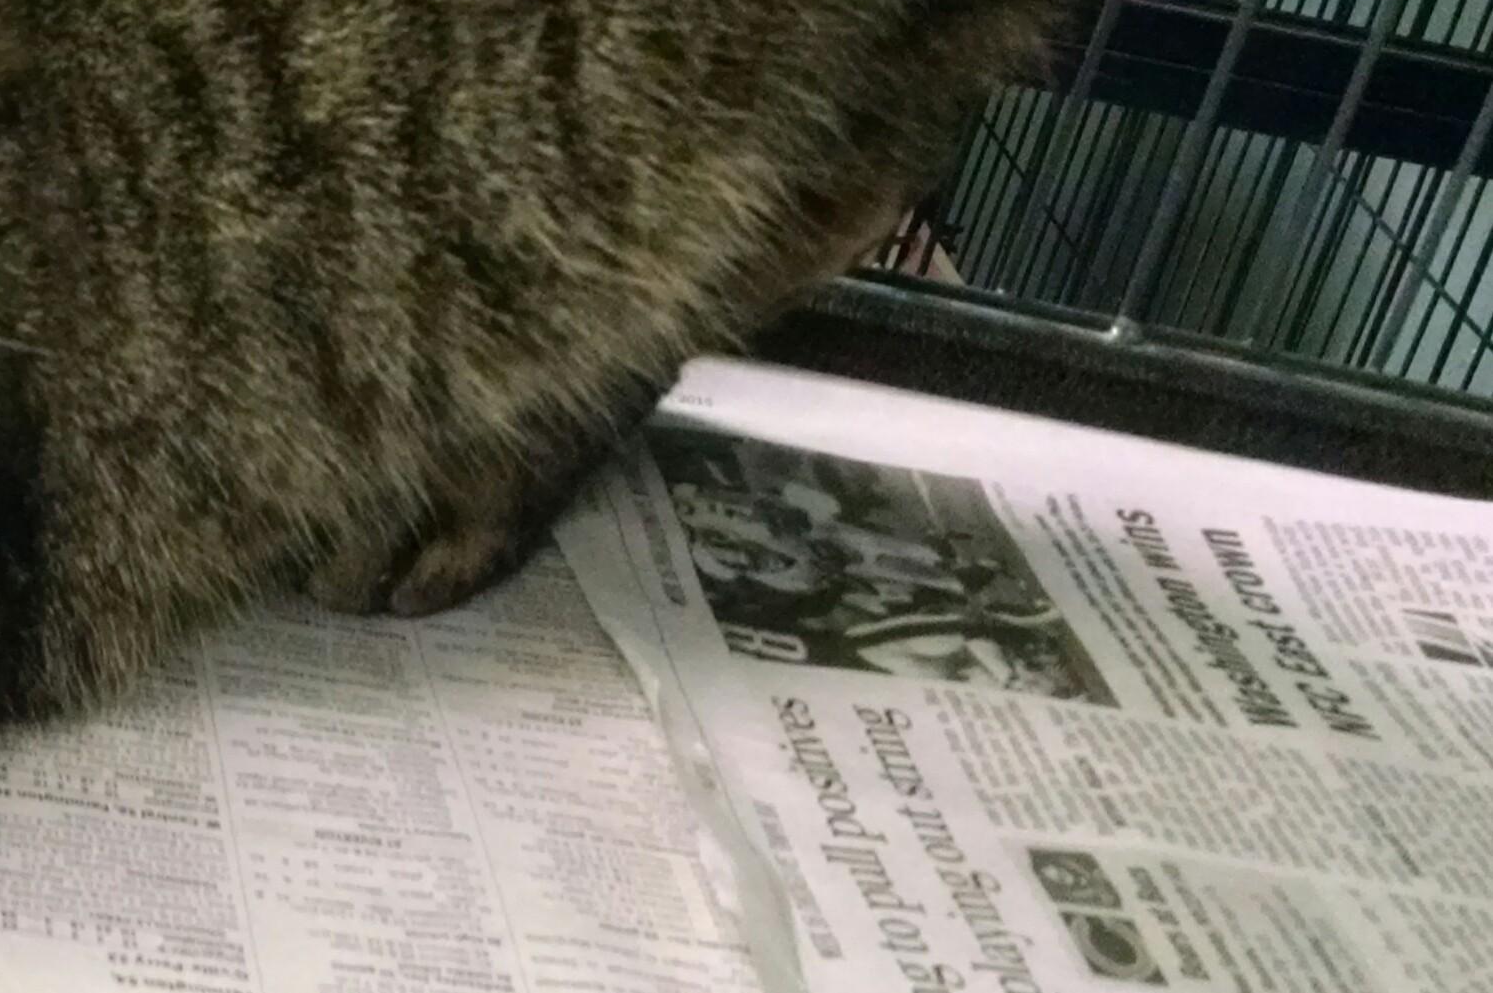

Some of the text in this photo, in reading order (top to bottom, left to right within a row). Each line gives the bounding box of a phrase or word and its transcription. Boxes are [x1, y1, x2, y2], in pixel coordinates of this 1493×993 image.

[1116, 508, 1300, 728] Washington wins
[1201, 527, 1383, 741] NFC East crown
[770, 694, 889, 844] positives
[852, 703, 934, 801] string
[819, 843, 928, 915] pull
[895, 805, 966, 864] out
[877, 916, 929, 953] to
